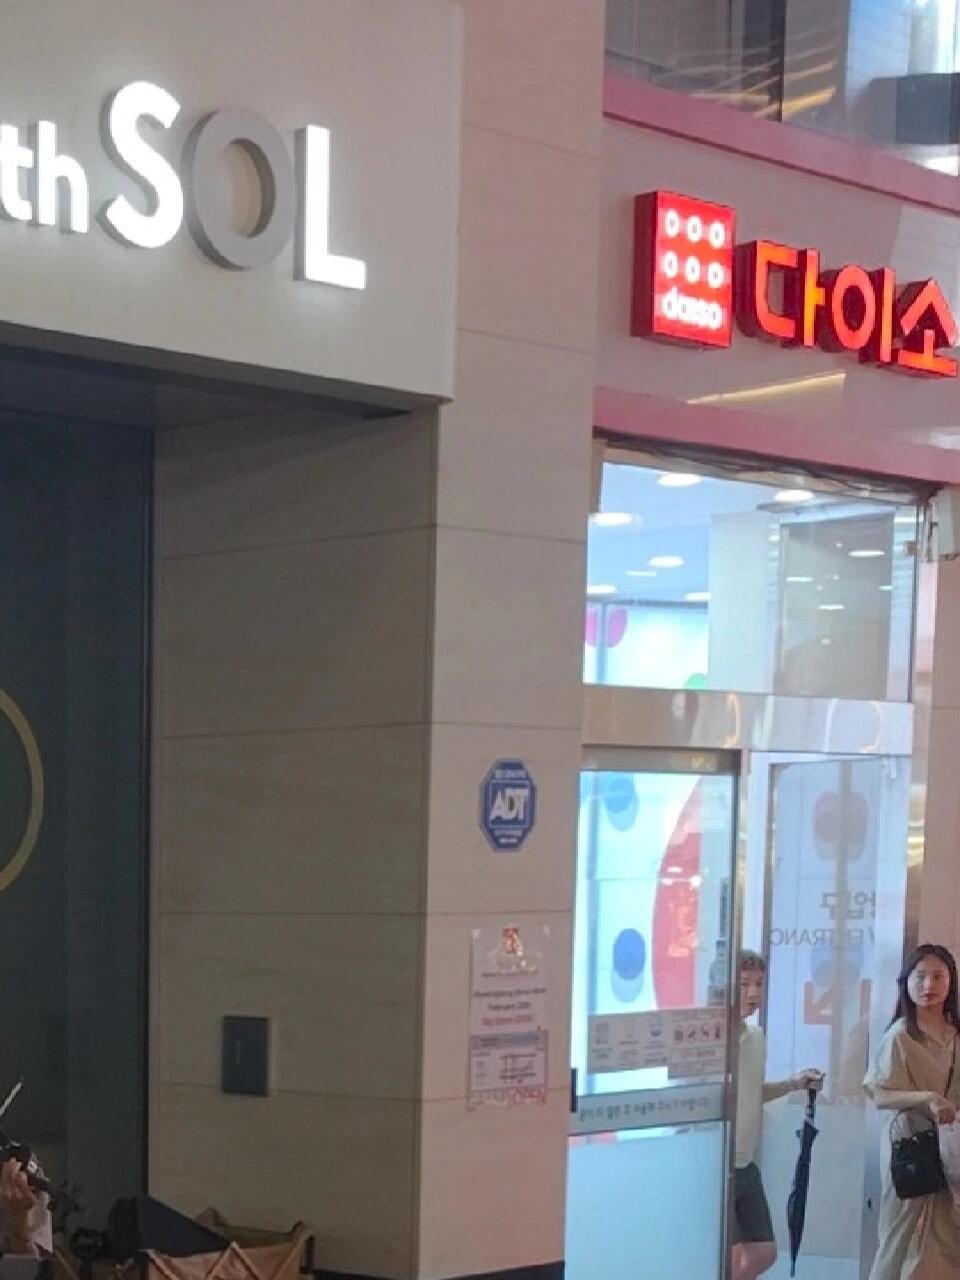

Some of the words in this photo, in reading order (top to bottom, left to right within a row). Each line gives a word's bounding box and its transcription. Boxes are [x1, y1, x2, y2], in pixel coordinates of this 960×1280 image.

[95, 79, 367, 290] SOL
[736, 239, 959, 378] 다이소
[490, 787, 530, 820] ADT
